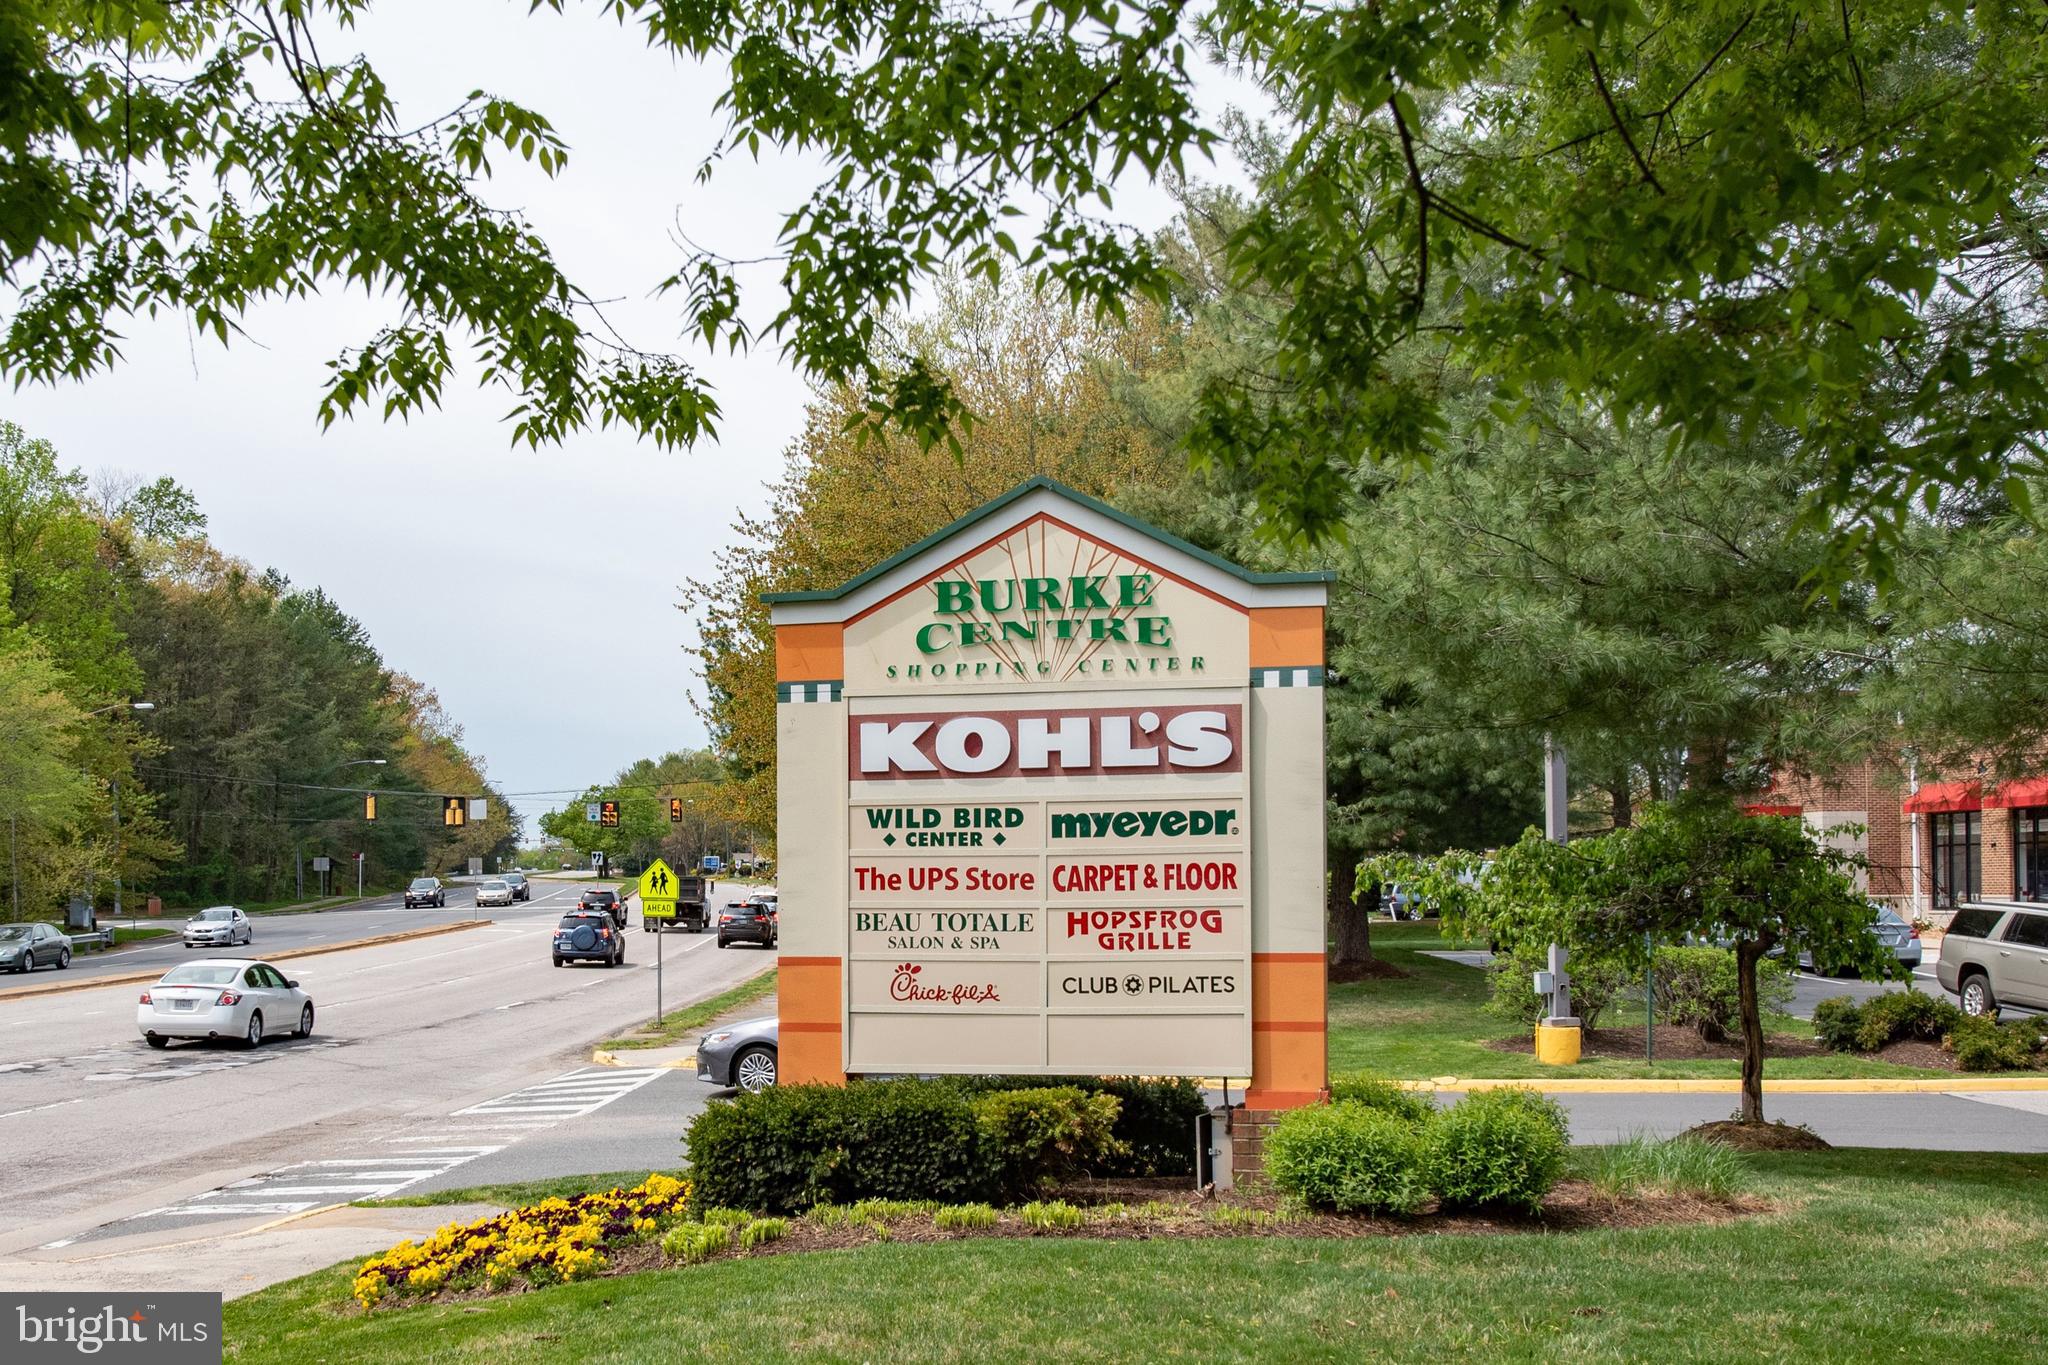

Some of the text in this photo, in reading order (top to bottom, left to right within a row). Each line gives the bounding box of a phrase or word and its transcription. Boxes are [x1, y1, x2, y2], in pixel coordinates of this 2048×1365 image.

[933, 574, 1153, 614] BURKE
[915, 616, 1173, 655] CENTRE
[886, 655, 1207, 679] SHOPPING CENTER
[860, 711, 1233, 773] KOHL'S
[866, 807, 1024, 829] WILD BIRD
[905, 832, 983, 847] CENTER
[854, 867, 1035, 891] The UPS Store
[1052, 862, 1237, 892] CARPET & FLOOR
[647, 904, 672, 912] AHEAD
[855, 912, 1034, 932] BEAU TOTALE
[1067, 909, 1222, 938] HOPSFROG
[887, 936, 1000, 949] SALON & SPA
[1098, 931, 1191, 952] GRILLE
[890, 971, 1000, 1005] Chick-fil-A
[1062, 975, 1235, 994] CLUB PILATES
